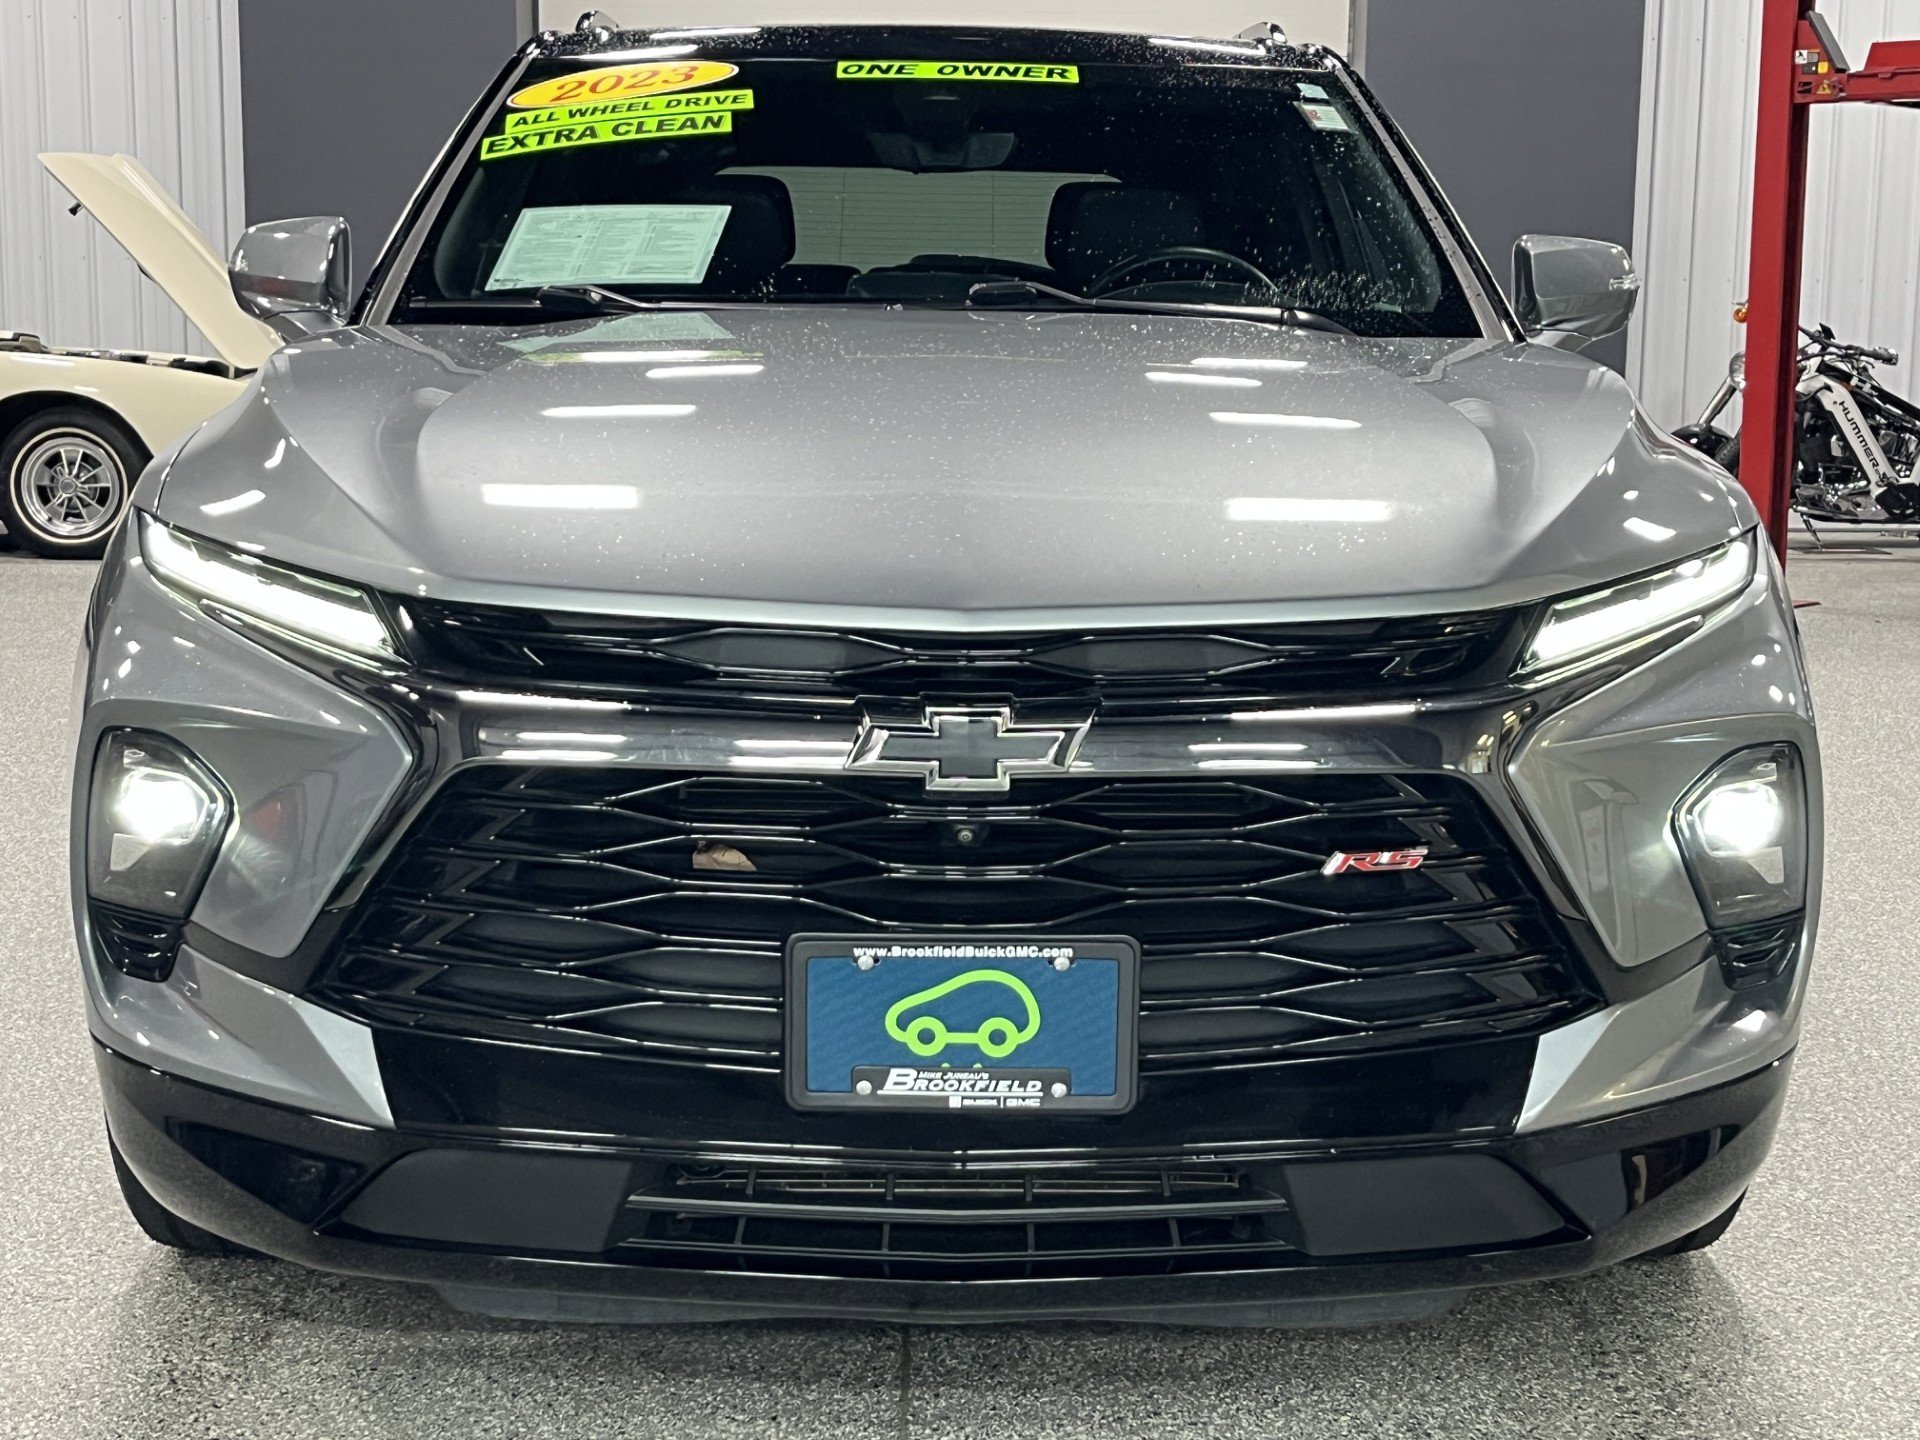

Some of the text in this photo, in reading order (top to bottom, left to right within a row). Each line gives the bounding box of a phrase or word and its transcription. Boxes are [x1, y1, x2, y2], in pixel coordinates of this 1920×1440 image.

[549, 65, 699, 103] 2023
[841, 63, 1072, 80] ONE OWNER
[511, 94, 749, 128] ALL WHEEL DRIVE
[485, 115, 725, 155] EXTRA CLEAN
[1838, 400, 1880, 472] HUMMER
[1320, 846, 1429, 875] RS
[852, 945, 1074, 958] www.BrookfieldBuickGMC.com
[882, 1067, 1043, 1093] BROOKFIELD
[1005, 1098, 1041, 1107] GMC
